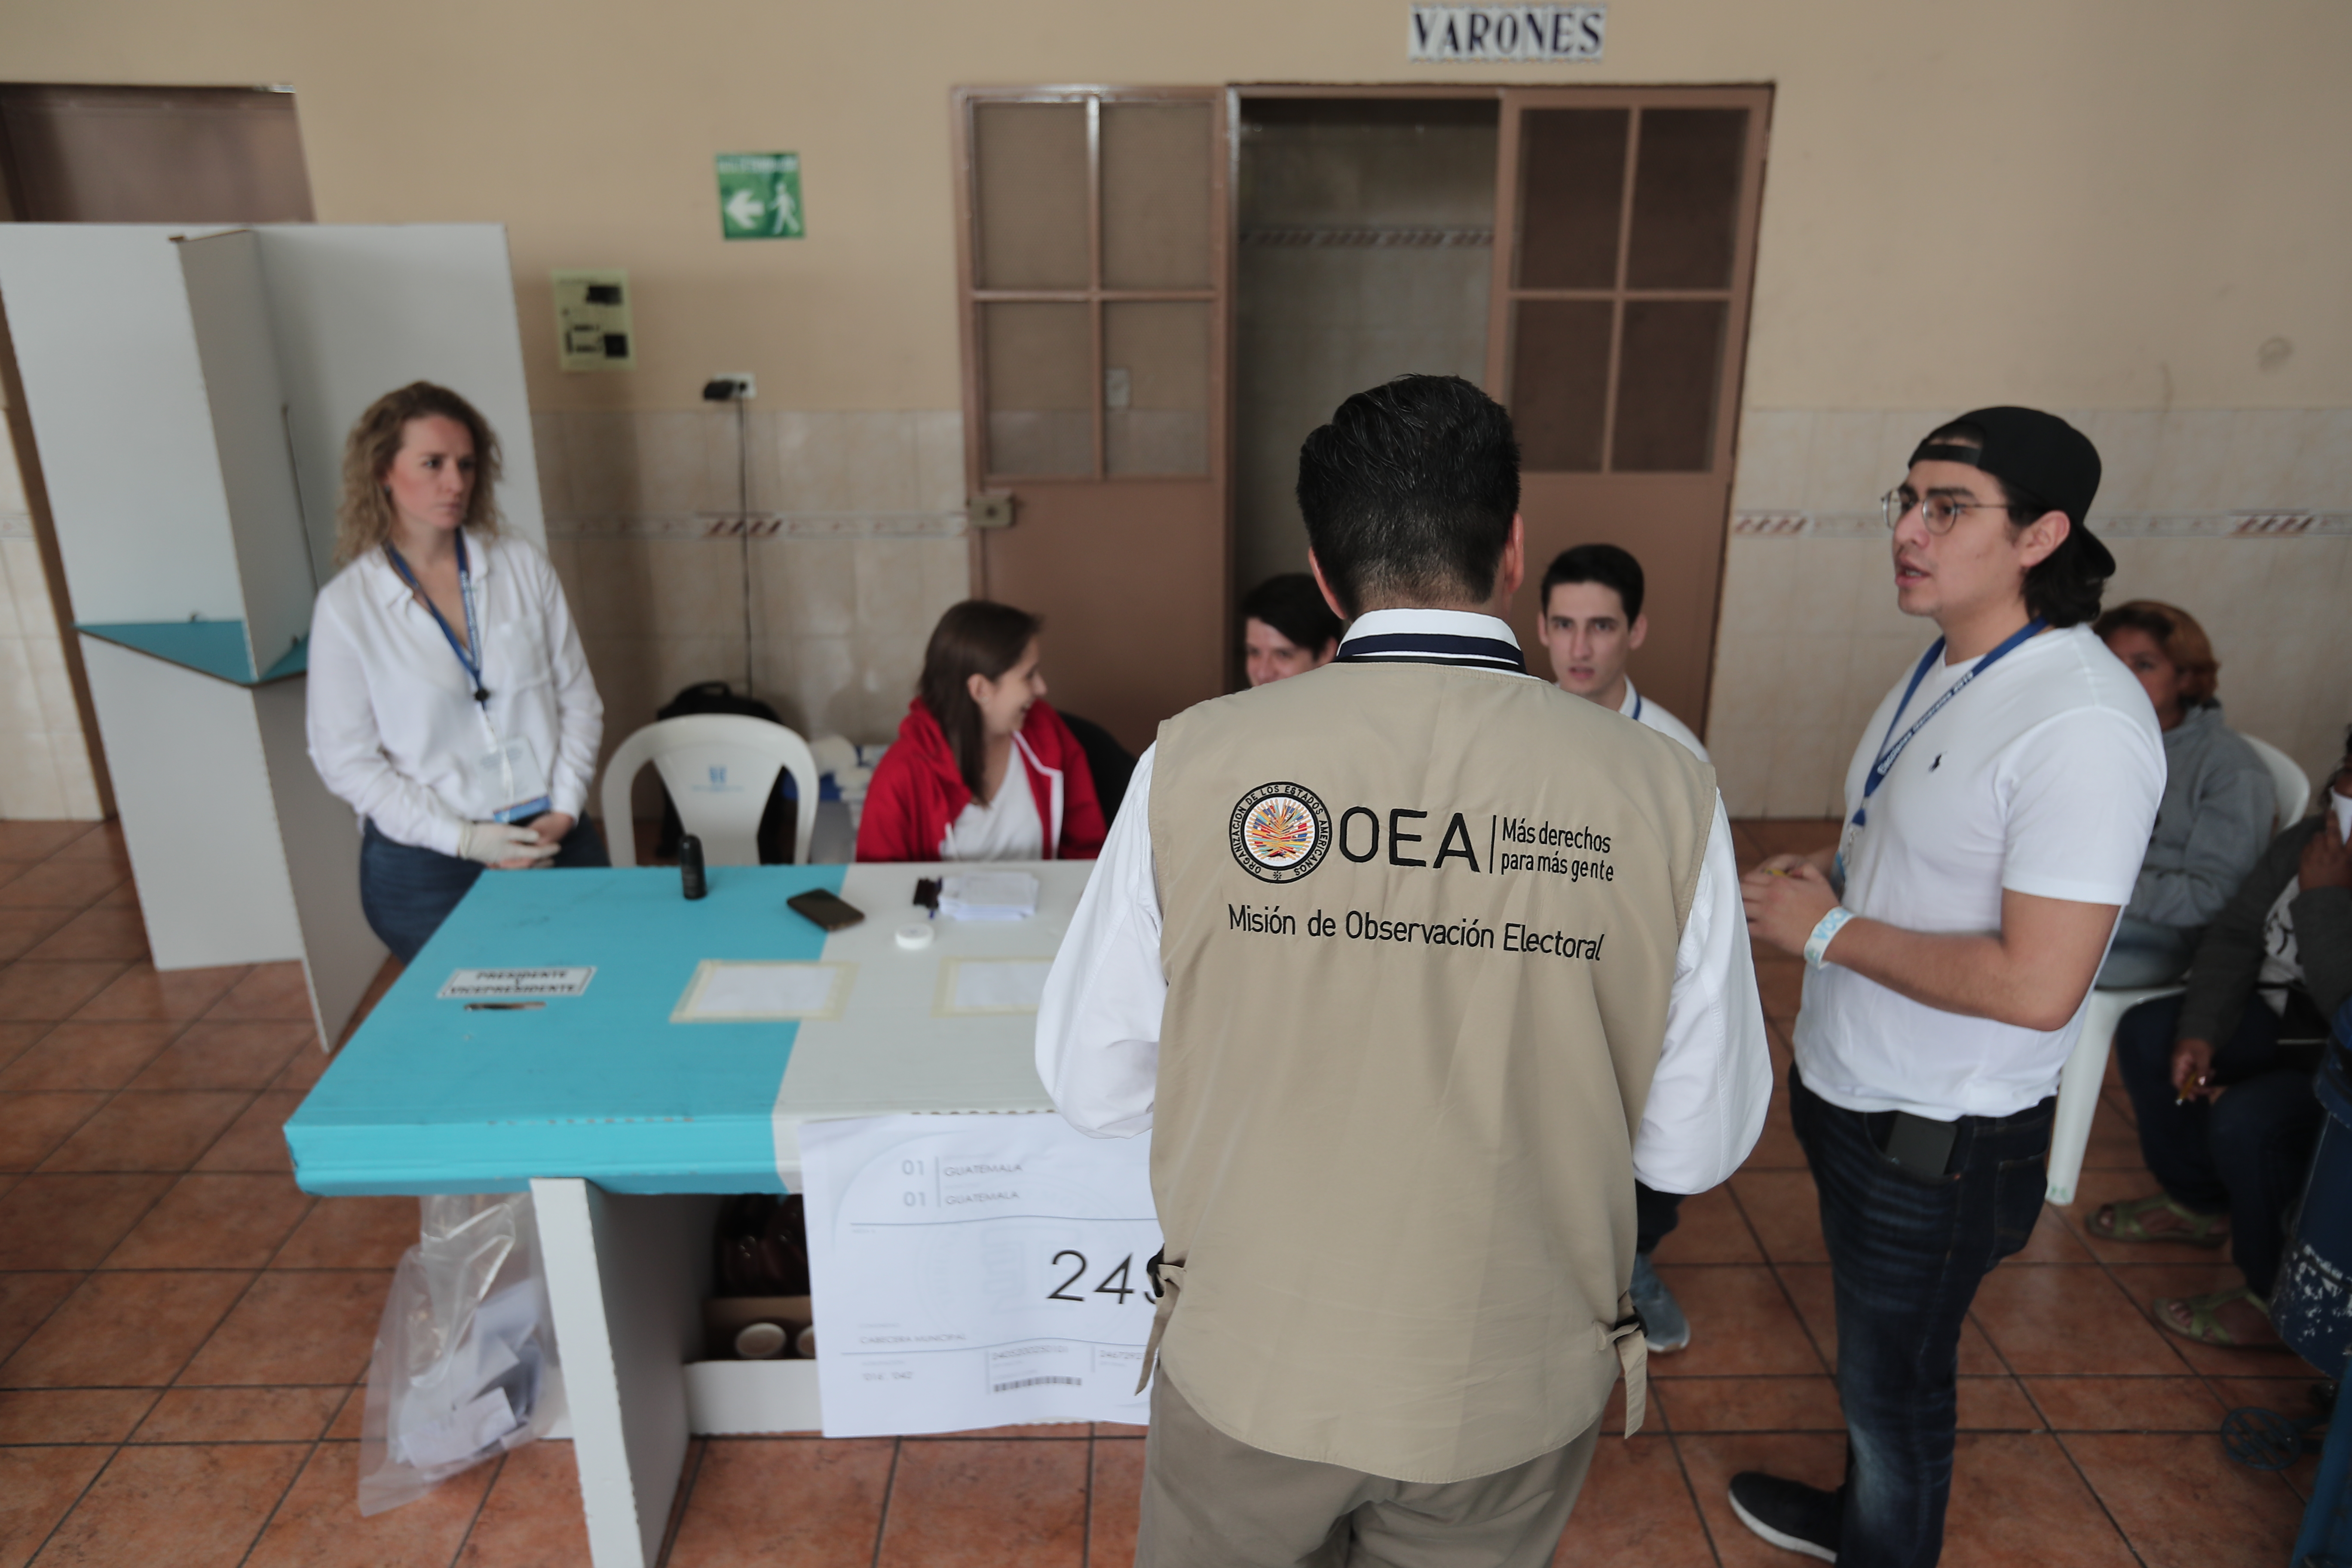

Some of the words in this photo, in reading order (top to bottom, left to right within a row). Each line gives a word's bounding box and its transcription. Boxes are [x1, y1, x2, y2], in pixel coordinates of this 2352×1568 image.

[1413, 13, 1602, 53] VARONES
[1246, 793, 1258, 805] DE
[1260, 785, 1280, 796] LOS
[1284, 786, 1323, 815] ESTADOS
[1231, 806, 1262, 874] ORGANIZACION
[1294, 820, 1329, 876] AMERICANOS
[1339, 806, 1481, 873] OEA
[1502, 816, 1536, 845] Más
[1539, 821, 1611, 854] derechos
[1501, 852, 1535, 875] para
[1537, 851, 1568, 874] más
[1571, 858, 1614, 882] gente
[1228, 903, 1296, 935] Misión
[1308, 909, 1336, 937] de
[1346, 910, 1495, 949] Observación
[1503, 922, 1605, 961] Electoral
[902, 1159, 924, 1176] 01
[944, 1163, 1023, 1176] GUATEMALA
[903, 1191, 926, 1207] 01
[945, 1191, 1020, 1205] GUATEMALA
[1045, 1249, 1156, 1305] 24
